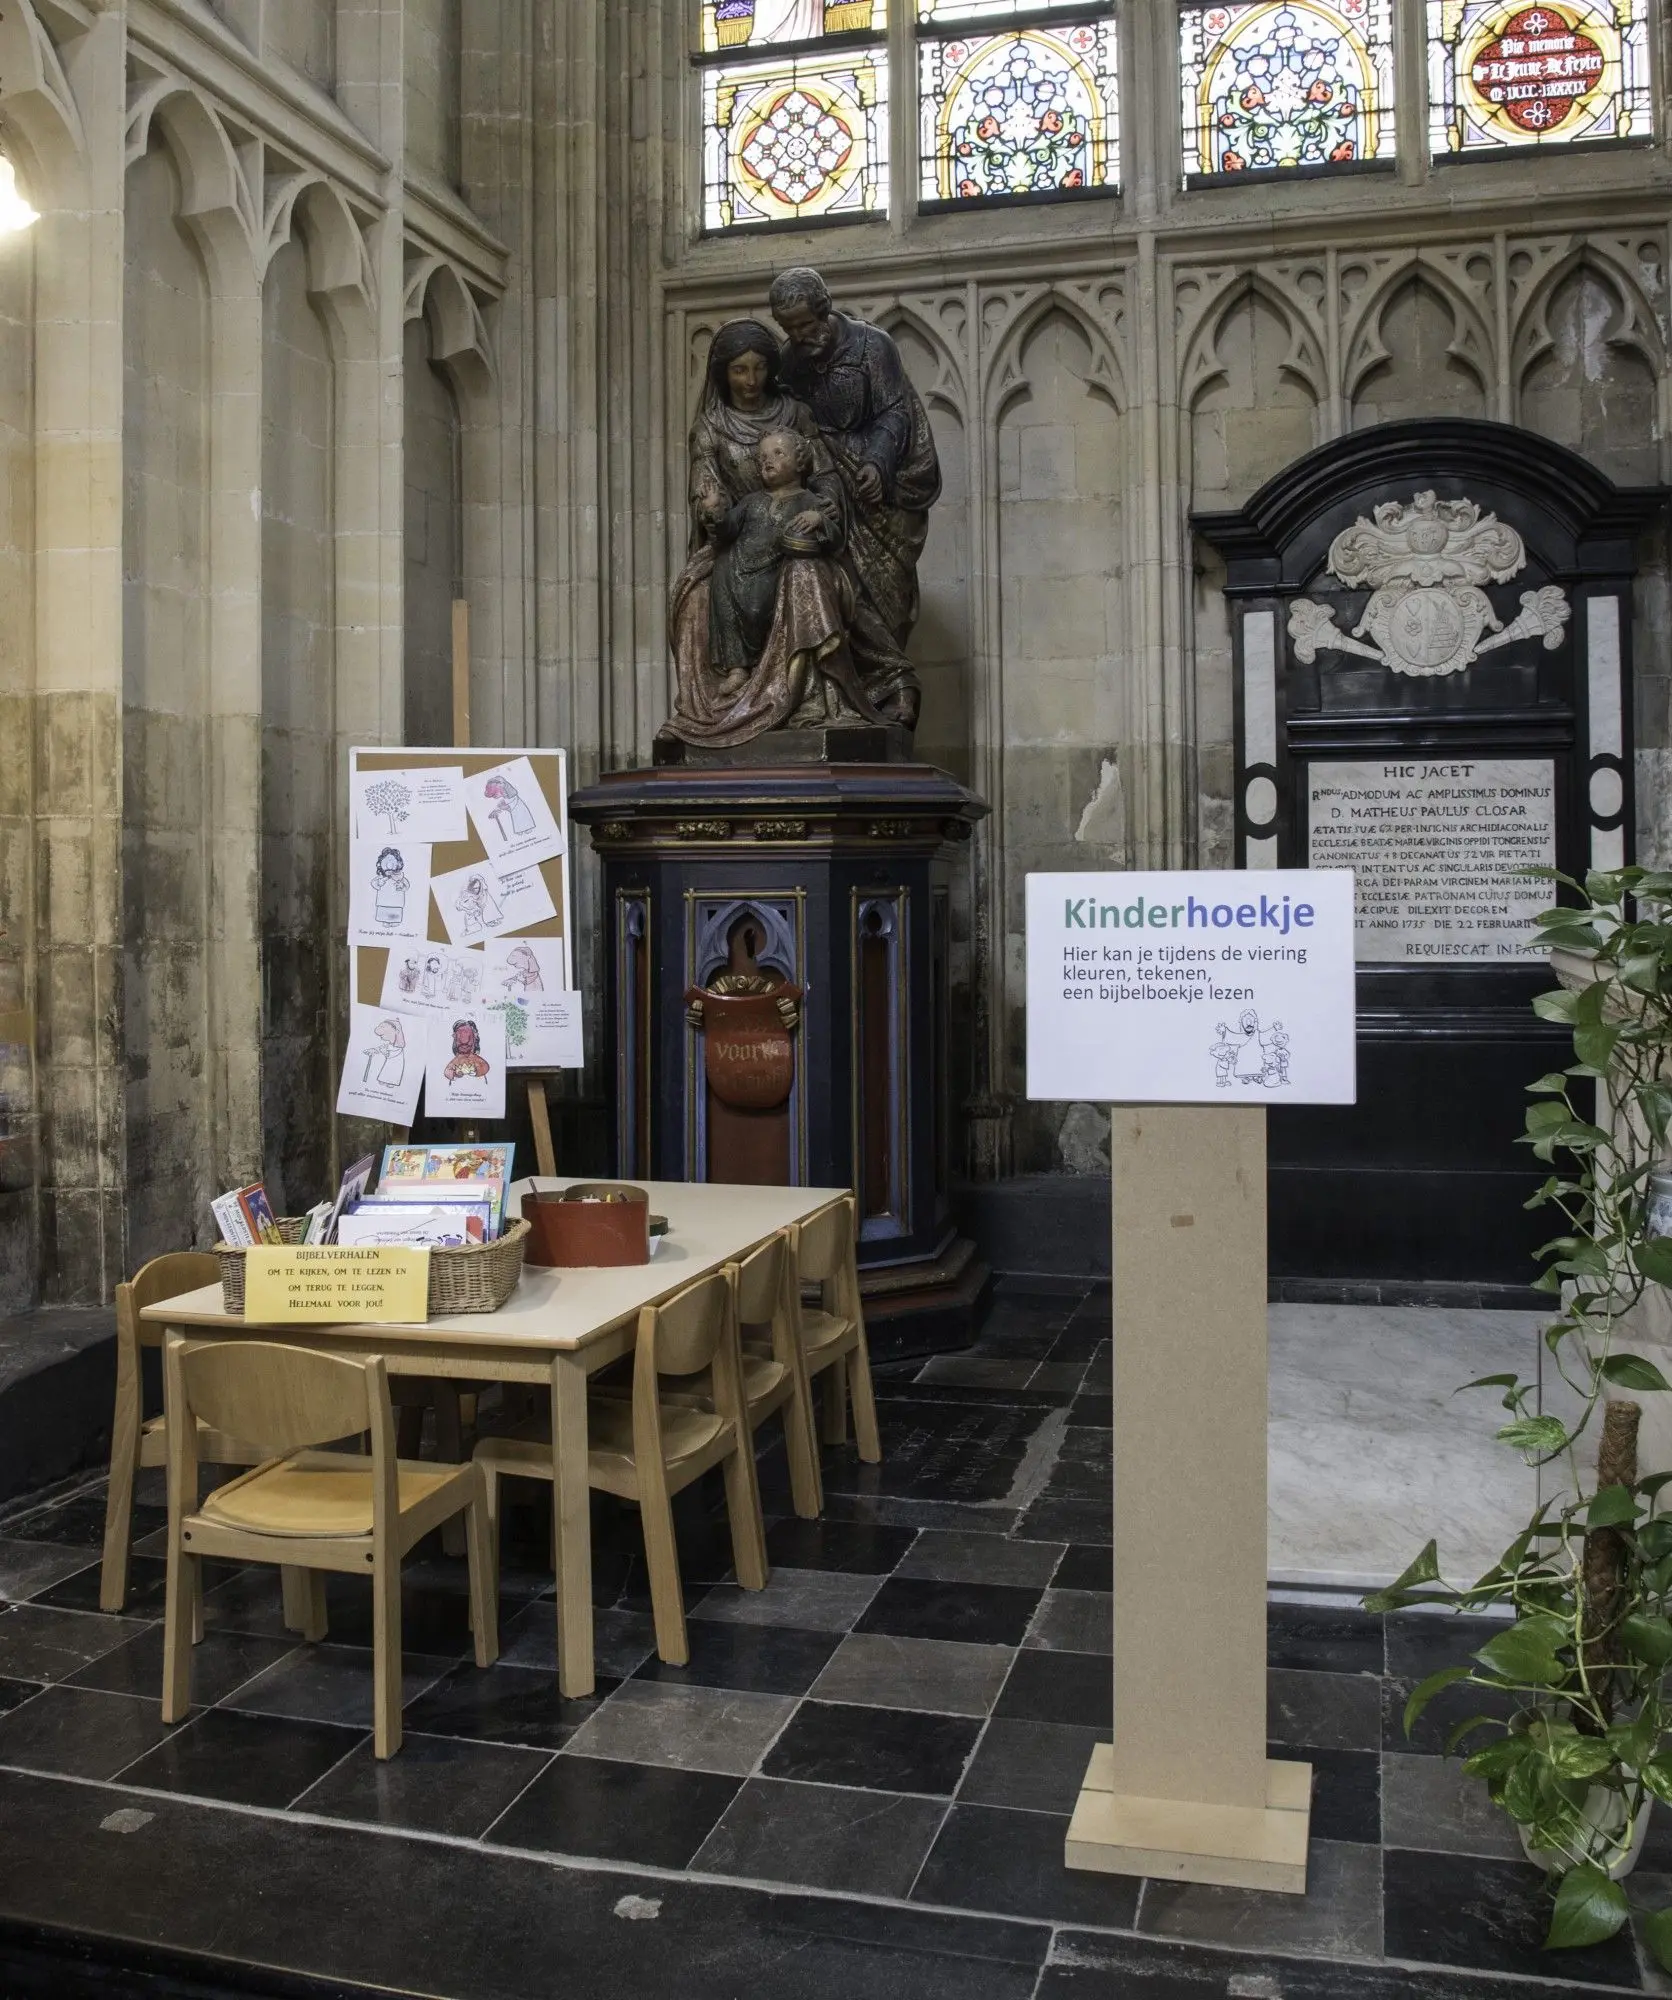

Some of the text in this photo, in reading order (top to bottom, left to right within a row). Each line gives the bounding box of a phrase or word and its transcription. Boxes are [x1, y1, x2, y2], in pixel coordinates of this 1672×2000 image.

[1383, 765, 1475, 780] HIC JACET
[1342, 790, 1401, 800] ADMODUM
[1406, 789, 1424, 799] AC
[1428, 788, 1497, 799] AMPLISSIMUS
[1500, 787, 1552, 798] DOMINUS
[1331, 804, 1527, 819] D. MATHEUS PAULUS CLOSAR
[1459, 823, 1549, 832] ARCHIDIACONALIS
[1463, 837, 1490, 846] OPPIDI
[1312, 851, 1380, 861] CANONICATUS
[1400, 850, 1460, 860] DECANATUS
[1479, 850, 1496, 859] VIR
[1498, 849, 1542, 859] PIETATI
[1361, 864, 1420, 873] INTENTUS
[1422, 863, 1437, 873] AC
[1438, 863, 1494, 873] SINGULARIS
[1355, 878, 1379, 887] RCA
[1441, 876, 1490, 887] VIRGINEM
[1491, 876, 1533, 886] MARIAM
[1534, 875, 1555, 886] PER
[1414, 891, 1477, 901] PATRONAM
[1513, 890, 1554, 900] DOMUS
[1064, 895, 1315, 935] Kinderhoekje
[1407, 904, 1452, 915] DILEXIT
[1454, 905, 1508, 915] DECOREM
[1368, 919, 1399, 929] ANNO
[1402, 919, 1426, 929] 1735
[1434, 919, 1453, 929] DIE
[1457, 919, 1475, 929] 22
[1063, 945, 1307, 965] Hier kan je tijdens de viering
[1406, 943, 1490, 957] REQUIESCAT
[1497, 943, 1514, 956] IN
[1063, 965, 1213, 983] kleuren, tekenen,
[1063, 984, 1254, 1003] een bijbelboekje lezen
[296, 1250, 380, 1261] BIJBELVERHALEN
[267, 1268, 280, 1276] OM
[285, 1268, 295, 1276] TE
[299, 1268, 330, 1277] KIJKEN,
[366, 1268, 391, 1276] LEZEN
[396, 1267, 407, 1275] EN
[306, 1284, 332, 1292] TERUG
[337, 1284, 346, 1292] TE
[351, 1284, 385, 1292] LEGGEN.
[337, 1300, 361, 1308] VOOR
[365, 1299, 383, 1309] JOU!
